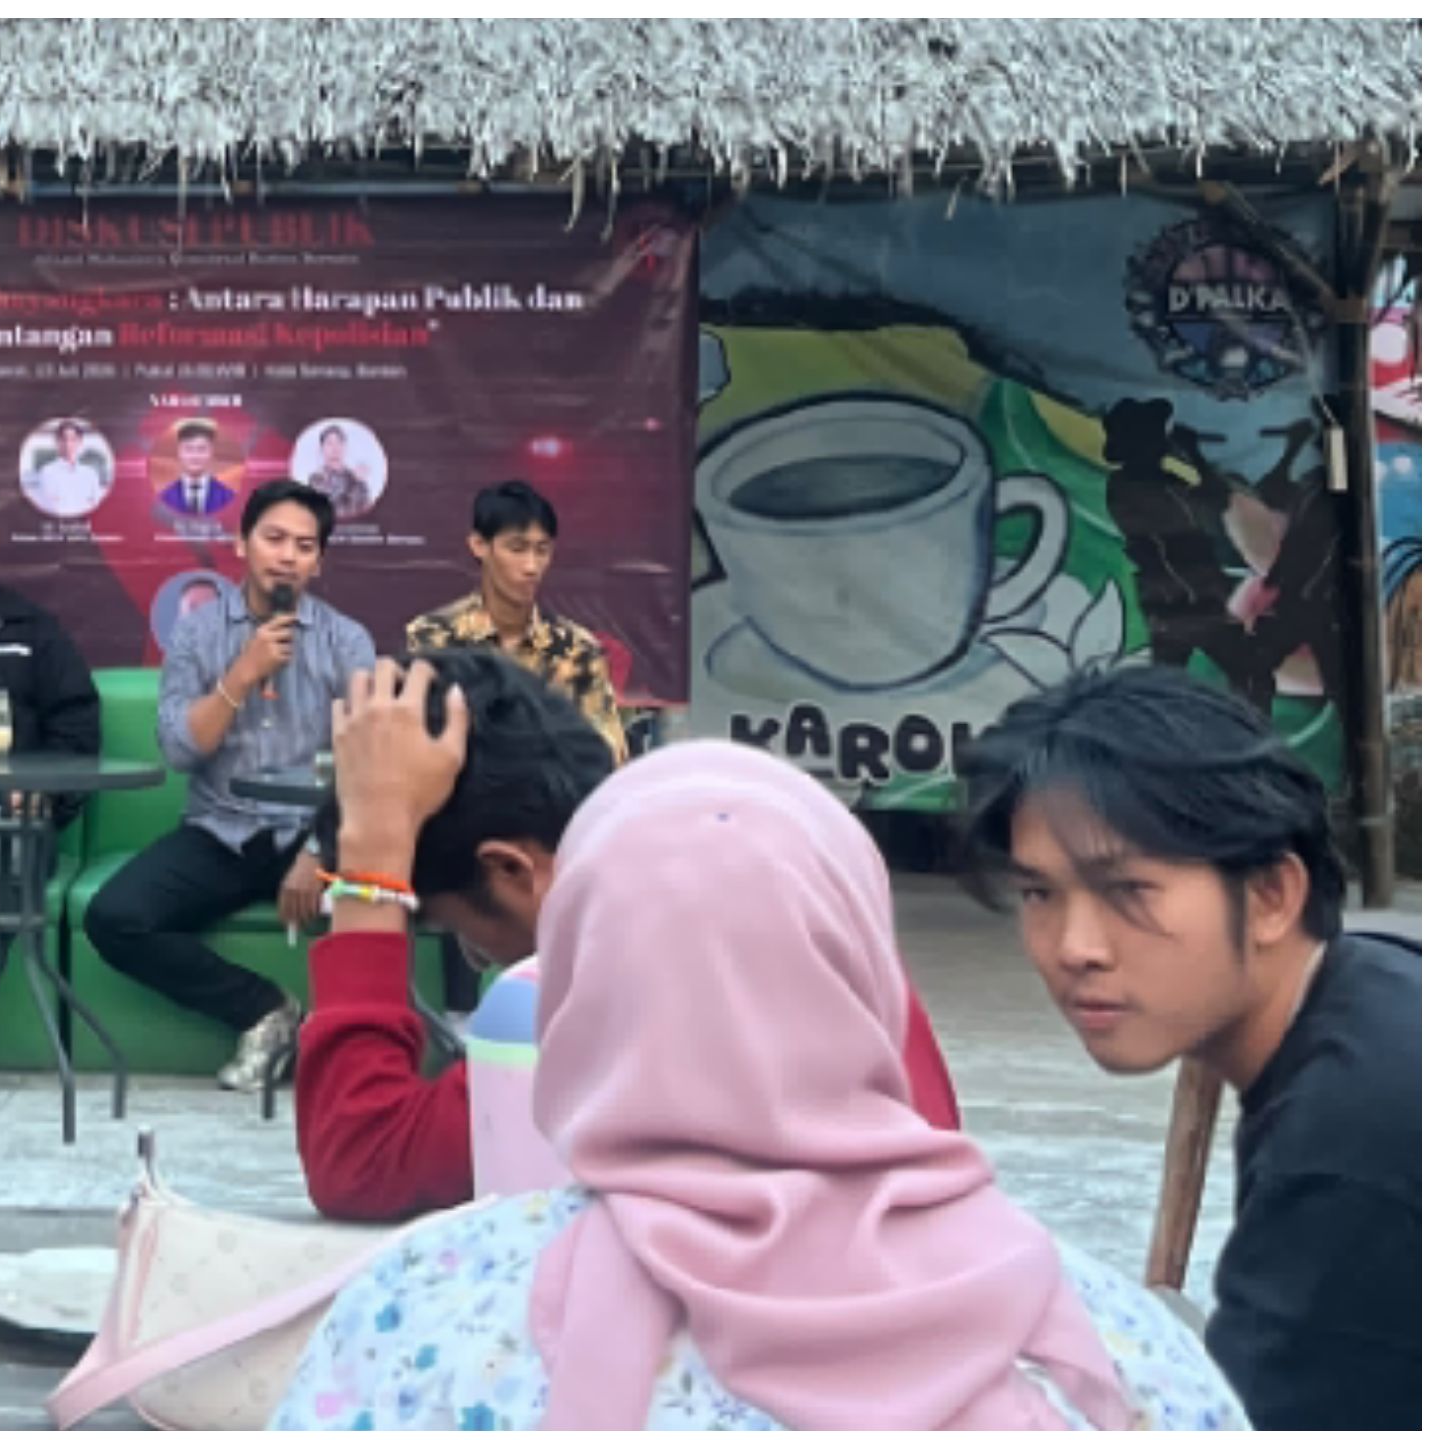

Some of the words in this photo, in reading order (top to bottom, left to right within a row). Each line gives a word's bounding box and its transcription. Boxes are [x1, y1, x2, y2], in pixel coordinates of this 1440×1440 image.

[186, 286, 286, 310] Antara
[291, 284, 417, 317] Harapan
[424, 284, 522, 310] Publik
[527, 284, 584, 310] dan
[1168, 283, 1292, 313] D'PALKA
